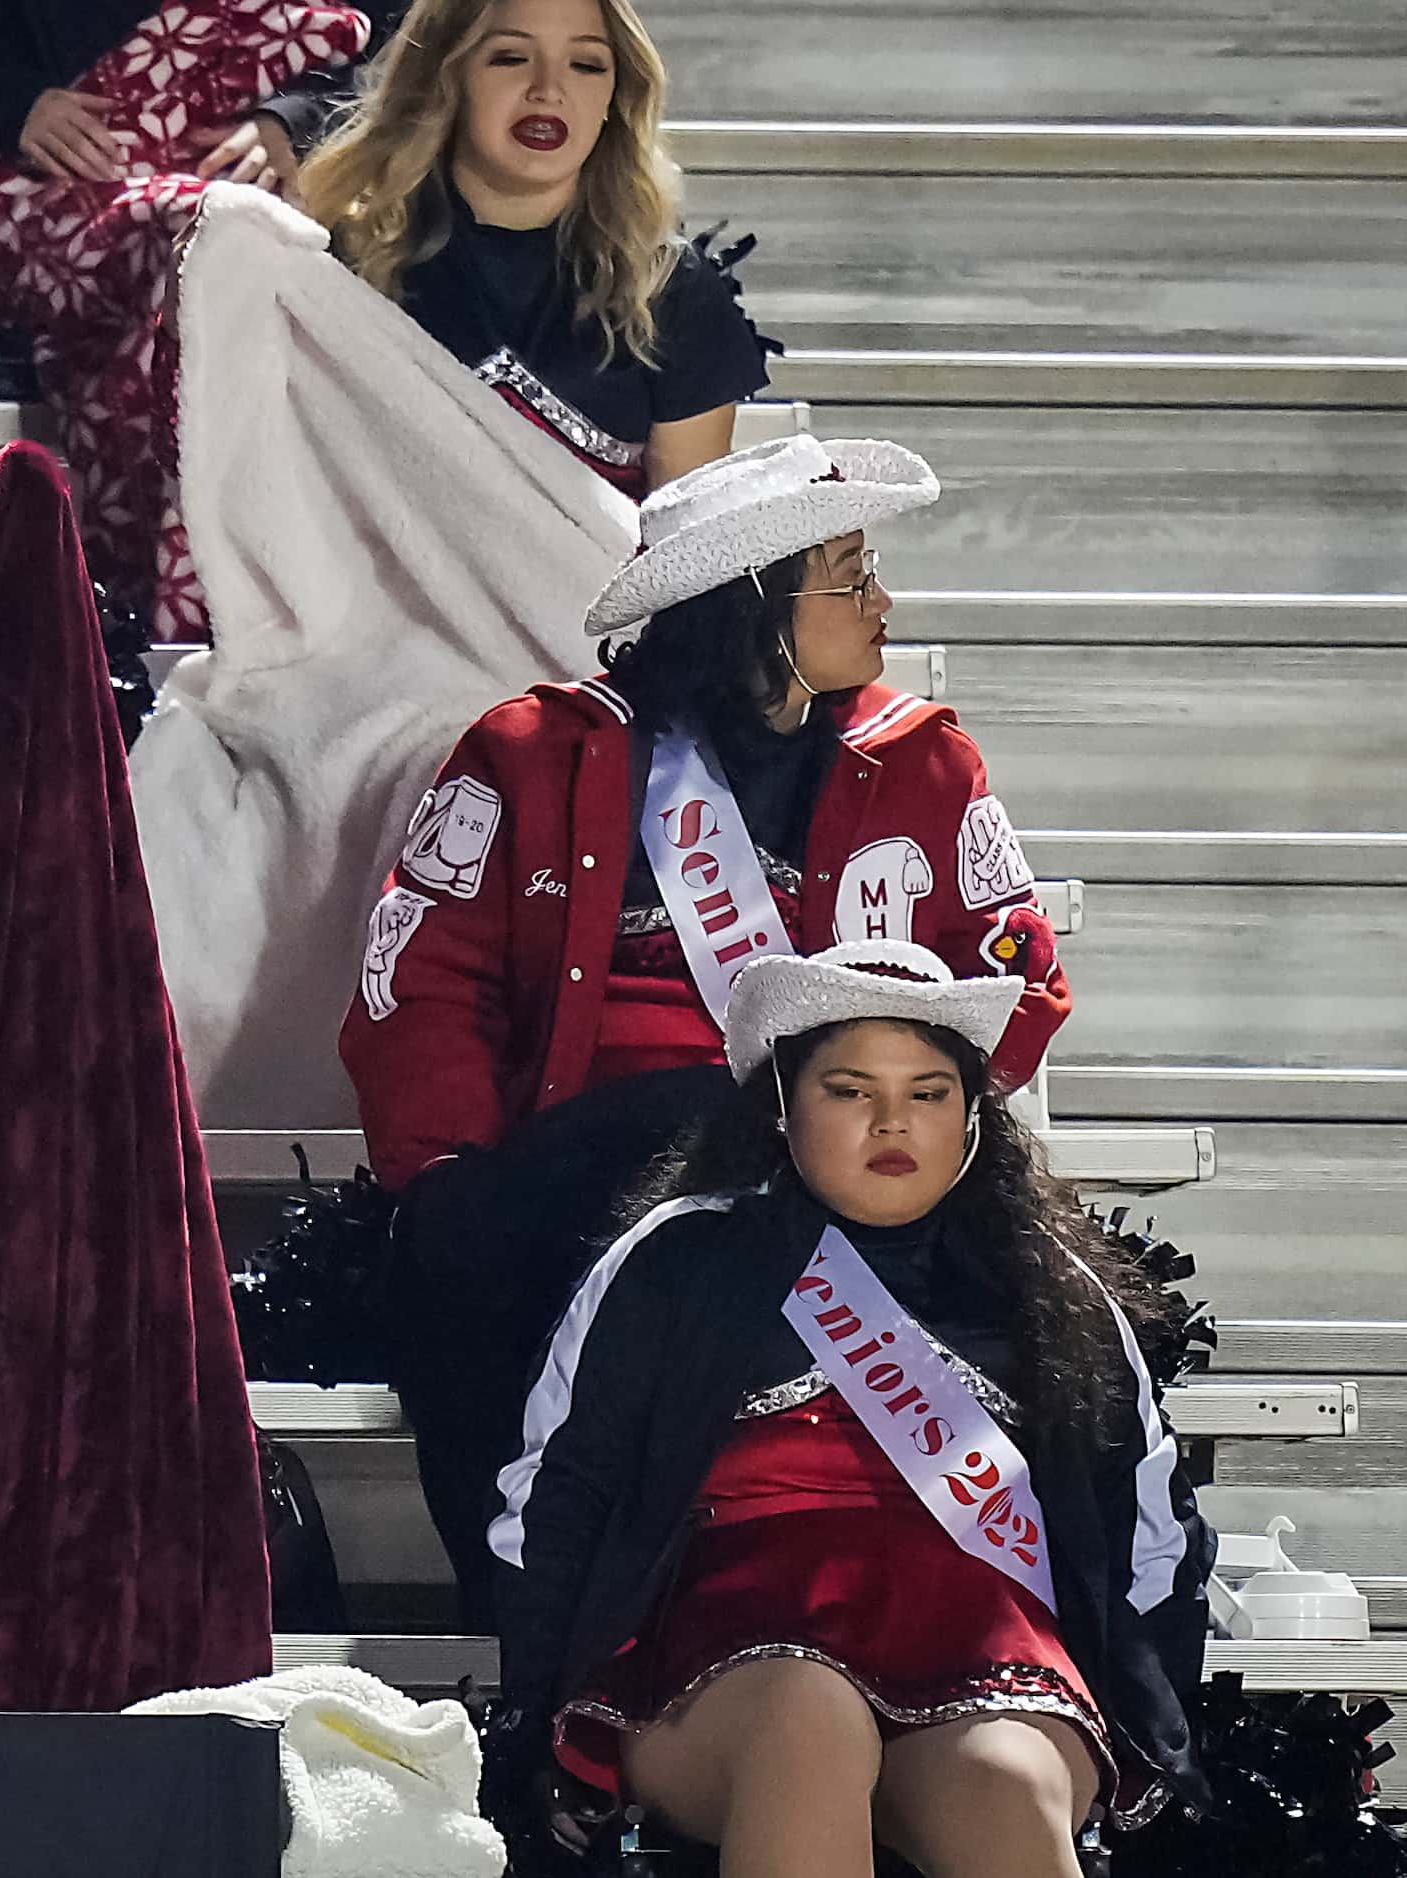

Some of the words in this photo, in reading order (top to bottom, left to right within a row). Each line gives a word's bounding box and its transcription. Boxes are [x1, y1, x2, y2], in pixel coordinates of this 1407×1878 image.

[524, 868, 569, 898] Jen
[657, 799, 769, 990] Seni
[794, 1247, 957, 1456] eniors
